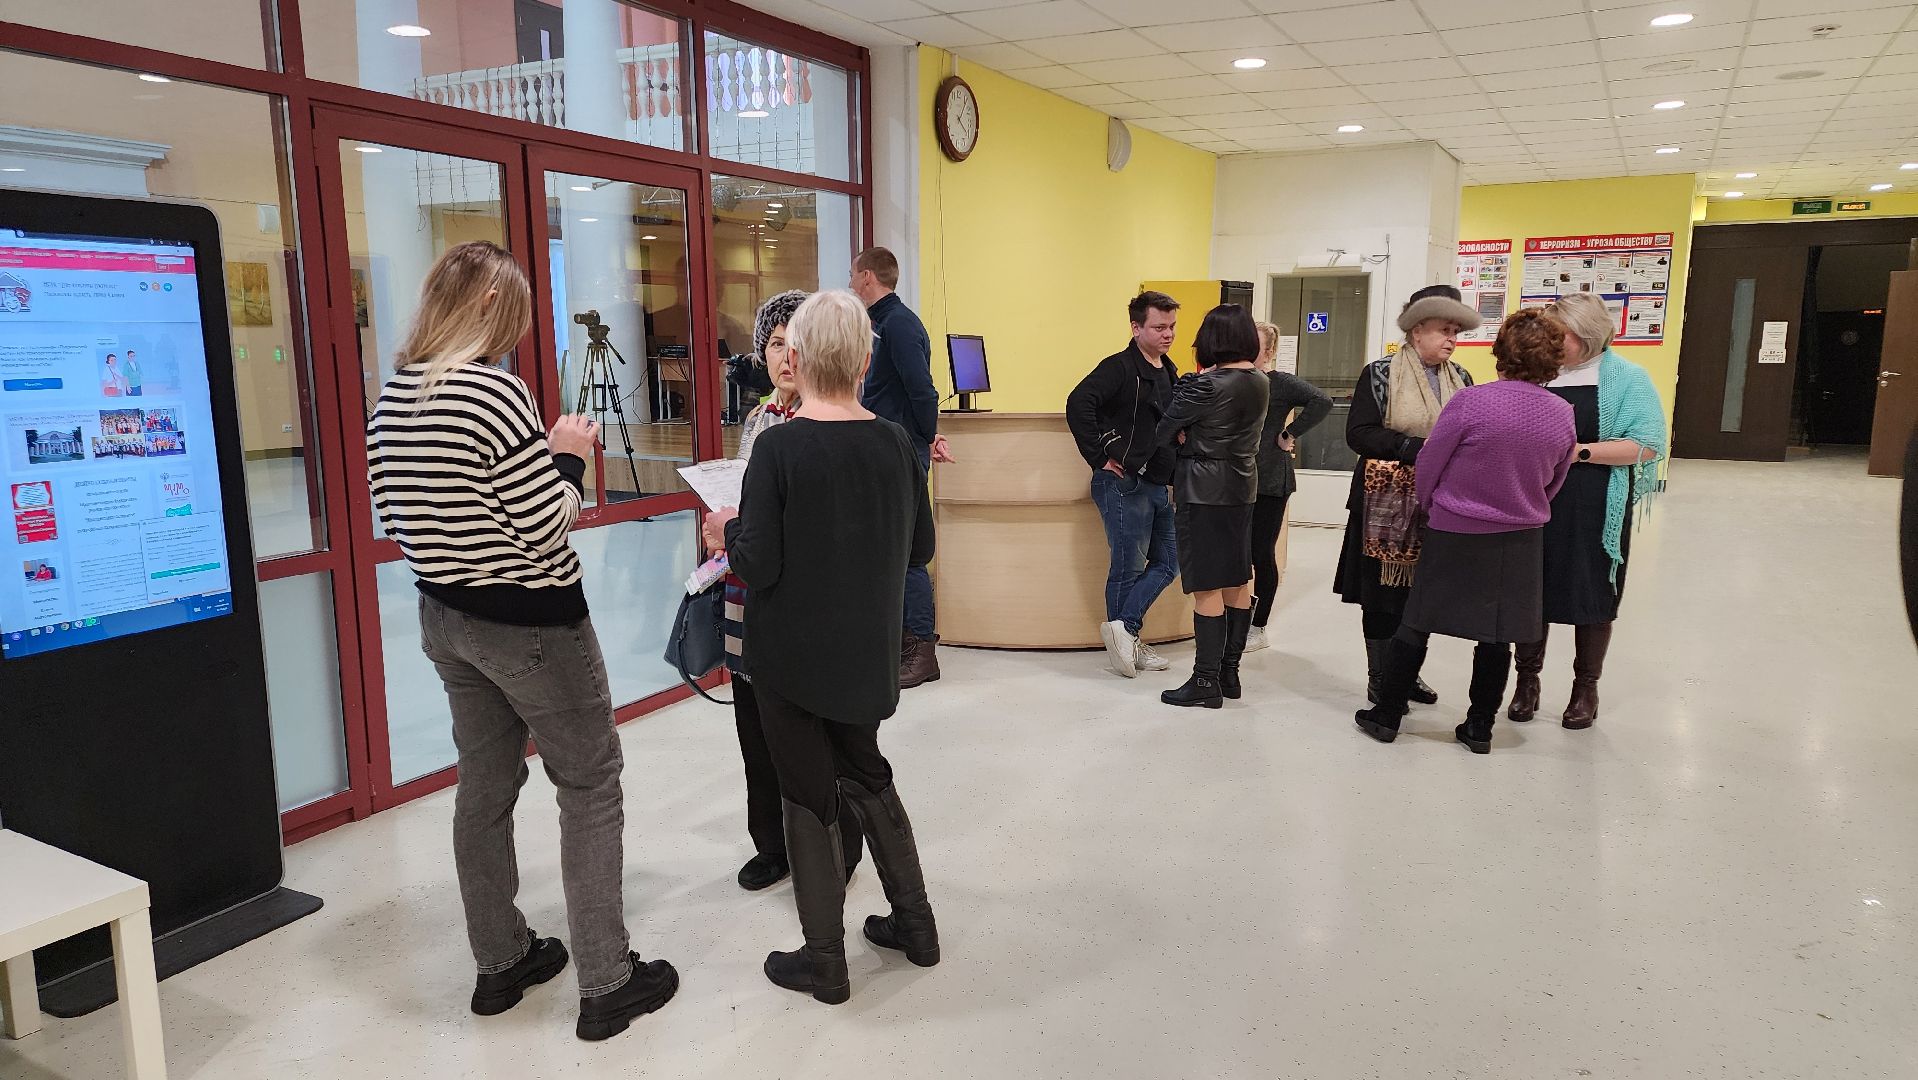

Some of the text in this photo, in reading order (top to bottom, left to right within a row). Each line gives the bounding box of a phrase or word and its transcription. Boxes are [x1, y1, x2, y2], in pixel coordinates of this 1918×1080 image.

[1540, 239, 1581, 250] ТЕРРОРИЗМ
[1586, 238, 1614, 248] УГРОЗА
[1614, 236, 1654, 247] ОБЩЕСТВУ
